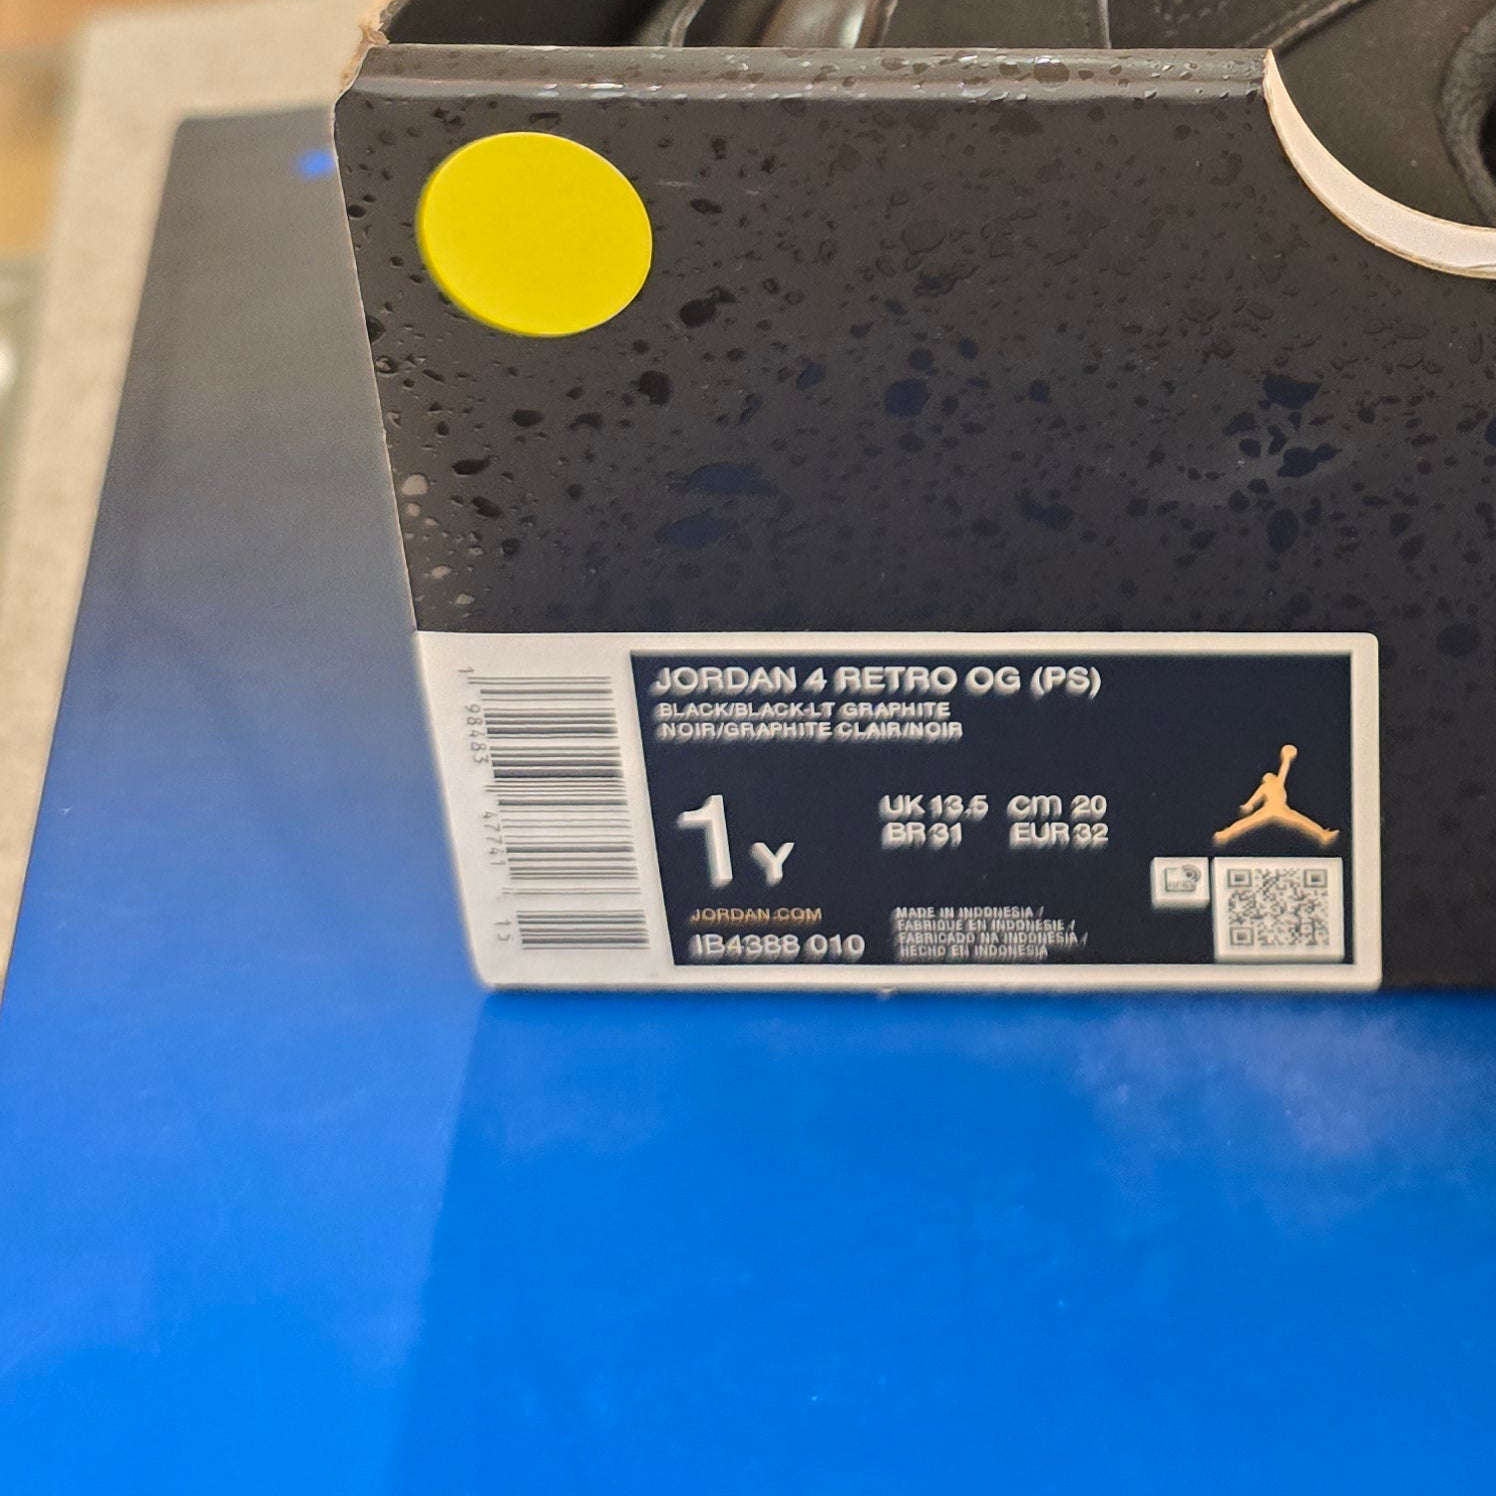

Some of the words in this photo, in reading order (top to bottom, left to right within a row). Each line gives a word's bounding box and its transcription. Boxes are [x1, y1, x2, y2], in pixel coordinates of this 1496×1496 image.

[652, 666, 797, 695] JORDAN
[802, 667, 828, 693] 4
[833, 666, 957, 695] RETRO
[965, 666, 1021, 695] OG
[1029, 666, 1101, 701] (PS)
[838, 702, 951, 720] GRAPHITE
[658, 722, 833, 741] NOIR/GRAPHITE
[834, 722, 963, 742] CLAIR/NOIR
[879, 794, 926, 821] UK
[1007, 794, 1062, 820] cm
[1070, 794, 1107, 820] 20
[882, 822, 926, 849] BR
[927, 822, 963, 850] 31
[1009, 822, 1070, 850] EUR
[1071, 822, 1109, 849] 32
[689, 908, 822, 927] JORDAN.COM
[893, 906, 936, 919] MADE
[938, 906, 955, 919] IN
[957, 906, 1035, 919] INDONESIA
[895, 919, 964, 932] FABRIQUE
[966, 919, 987, 932] EN
[802, 934, 866, 961] 010
[897, 932, 977, 946] FABRICADO
[978, 932, 999, 945] NA
[898, 944, 948, 958] HECHO
[949, 944, 971, 958] EN
[973, 944, 1049, 959] INDONESIA
